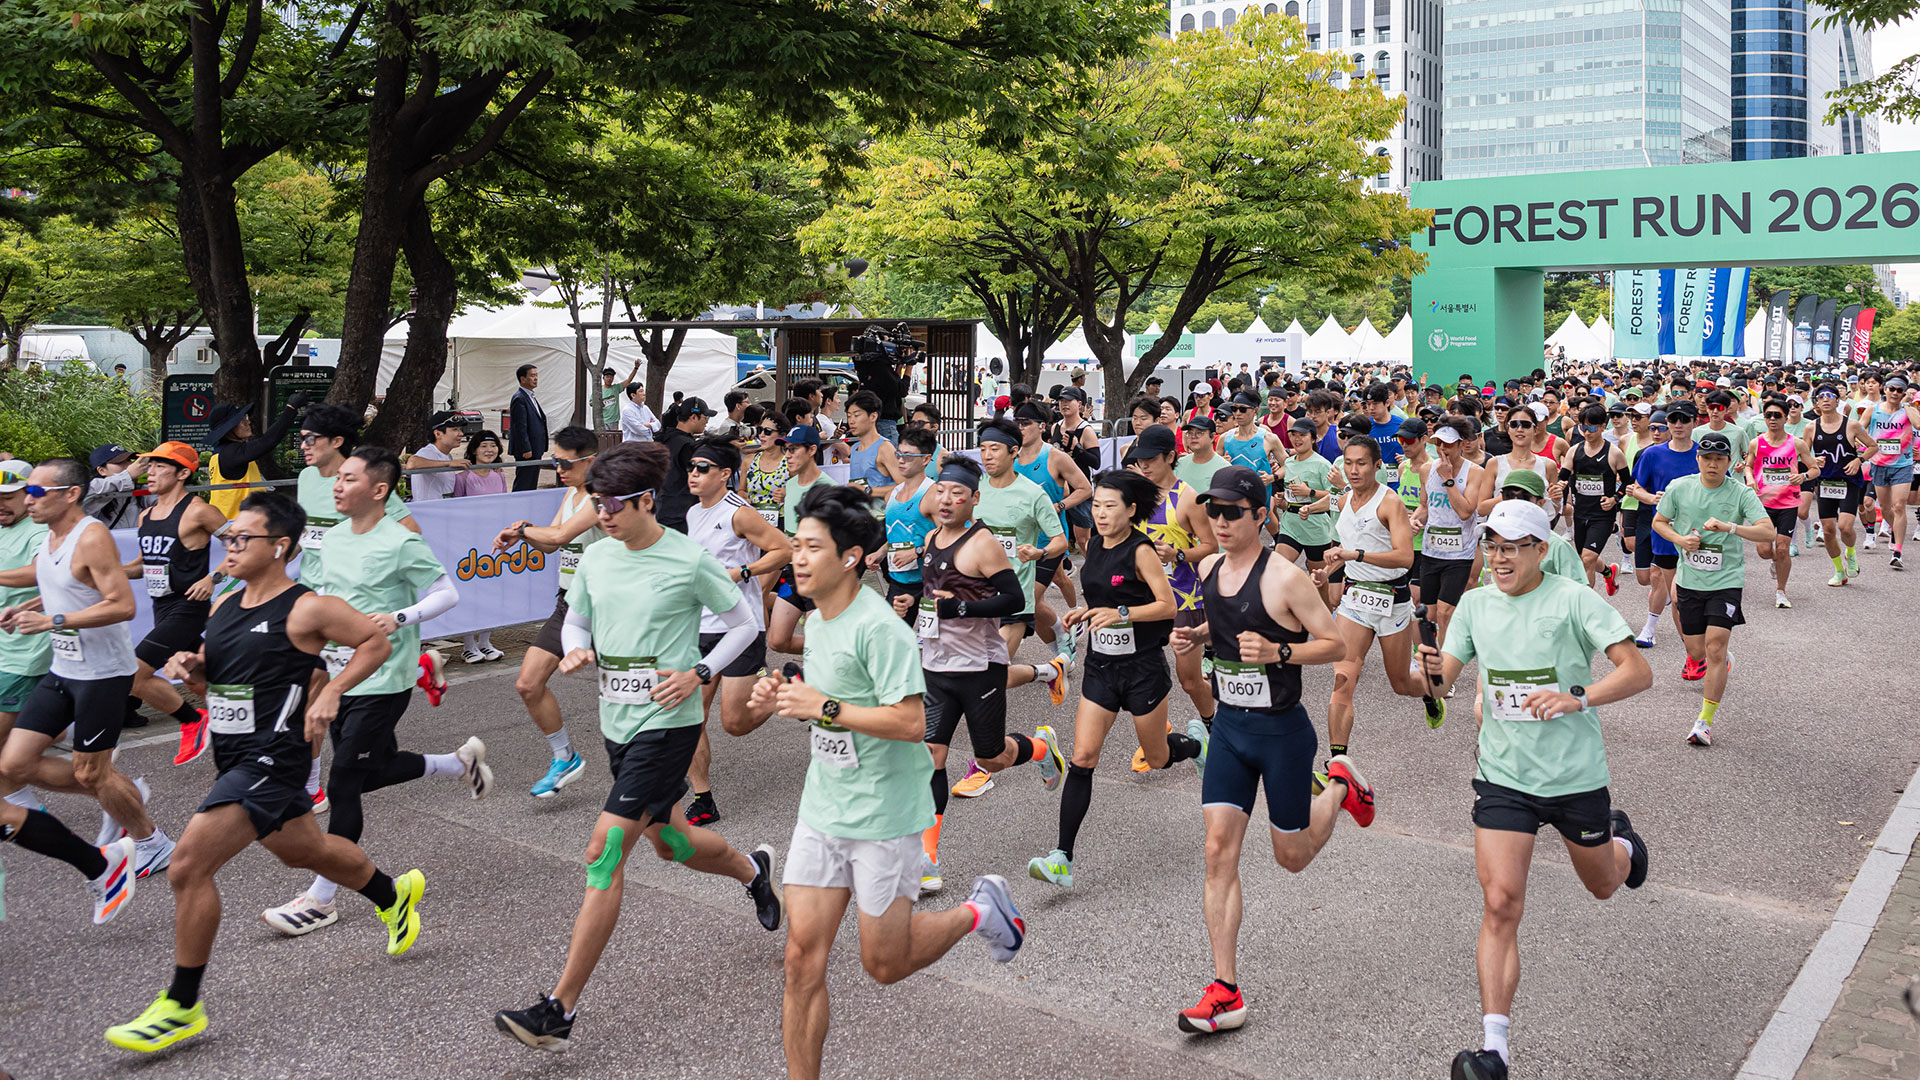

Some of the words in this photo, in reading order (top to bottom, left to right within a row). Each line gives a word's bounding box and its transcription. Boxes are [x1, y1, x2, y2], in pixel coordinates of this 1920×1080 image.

[1428, 198, 1618, 247] FOREST
[1633, 191, 1752, 238] RUN
[1768, 182, 1920, 233] 2026
[1439, 303, 1477, 313] 서울특별시
[1631, 280, 1643, 335] FOREST
[1678, 282, 1695, 333] FOREST
[1770, 305, 1783, 361] 파워에
[1177, 343, 1193, 351] 2026
[1876, 421, 1905, 430] RUNY
[1912, 430, 1920, 438] RU
[1762, 456, 1793, 465] RUNY
[310, 530, 323, 541] 25
[1437, 538, 1460, 546] 0421
[456, 542, 546, 581] darda
[1692, 554, 1719, 565] 0082
[1360, 594, 1390, 608] 0376
[1099, 633, 1130, 646] 0039
[610, 677, 652, 693] 0294
[1227, 681, 1263, 696] 0607
[210, 705, 248, 721] 0390
[814, 734, 849, 755] 0592
